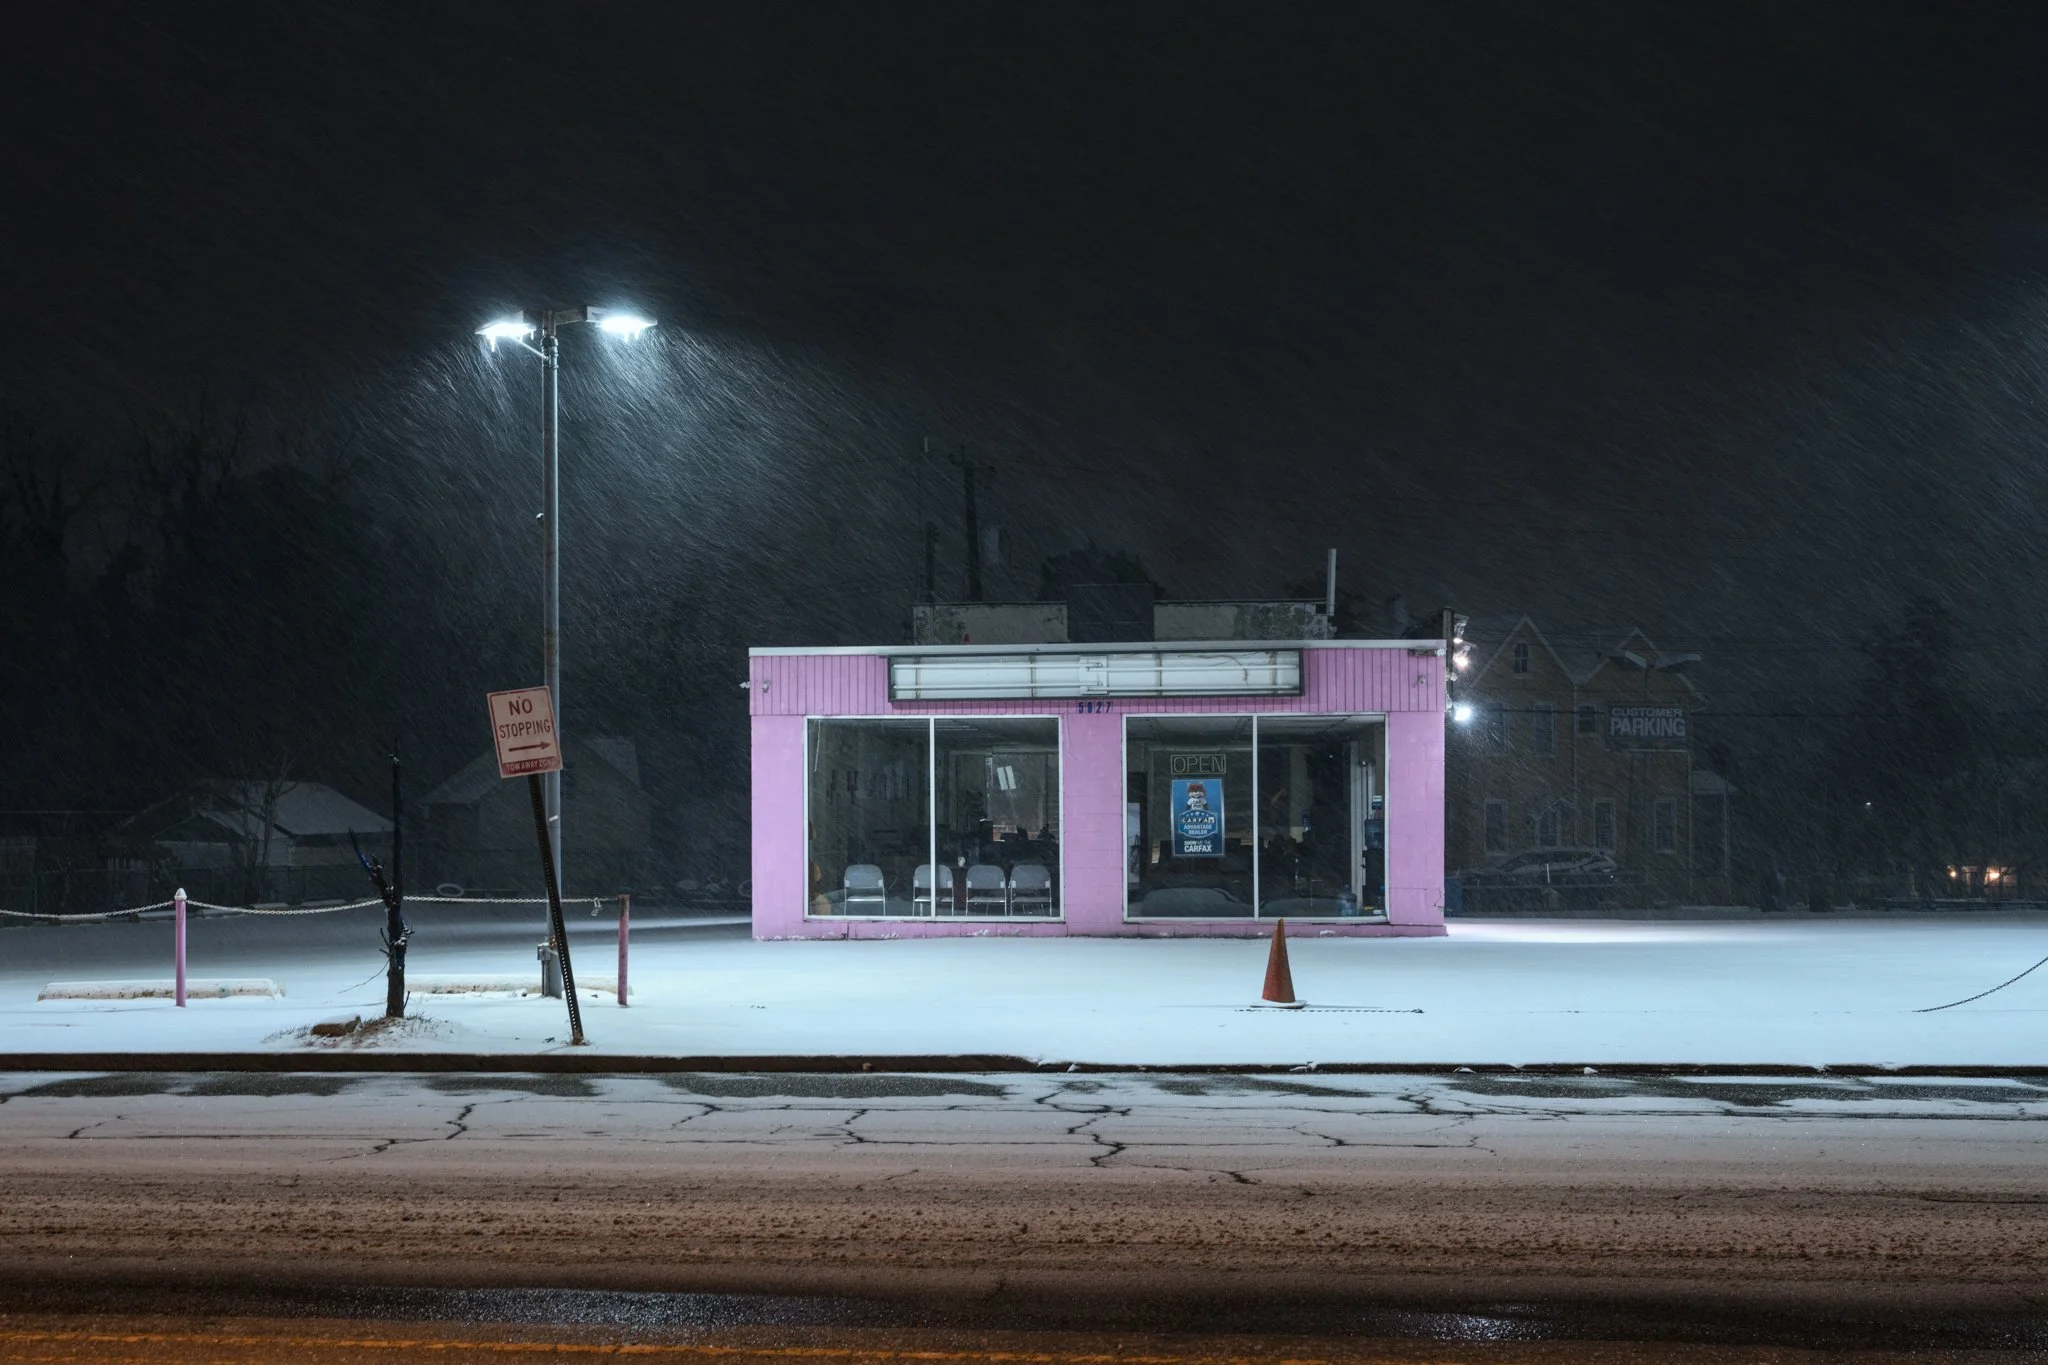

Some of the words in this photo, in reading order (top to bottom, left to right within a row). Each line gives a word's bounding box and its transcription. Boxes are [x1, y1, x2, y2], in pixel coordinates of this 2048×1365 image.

[508, 698, 533, 716] NO
[1611, 707, 1683, 717] CUSTOMER
[499, 719, 551, 739] STOPPING
[1610, 717, 1686, 737] PARKING
[521, 759, 538, 769] AWAY
[1173, 756, 1224, 773] OPEN
[1184, 845, 1213, 853] CARFAX
